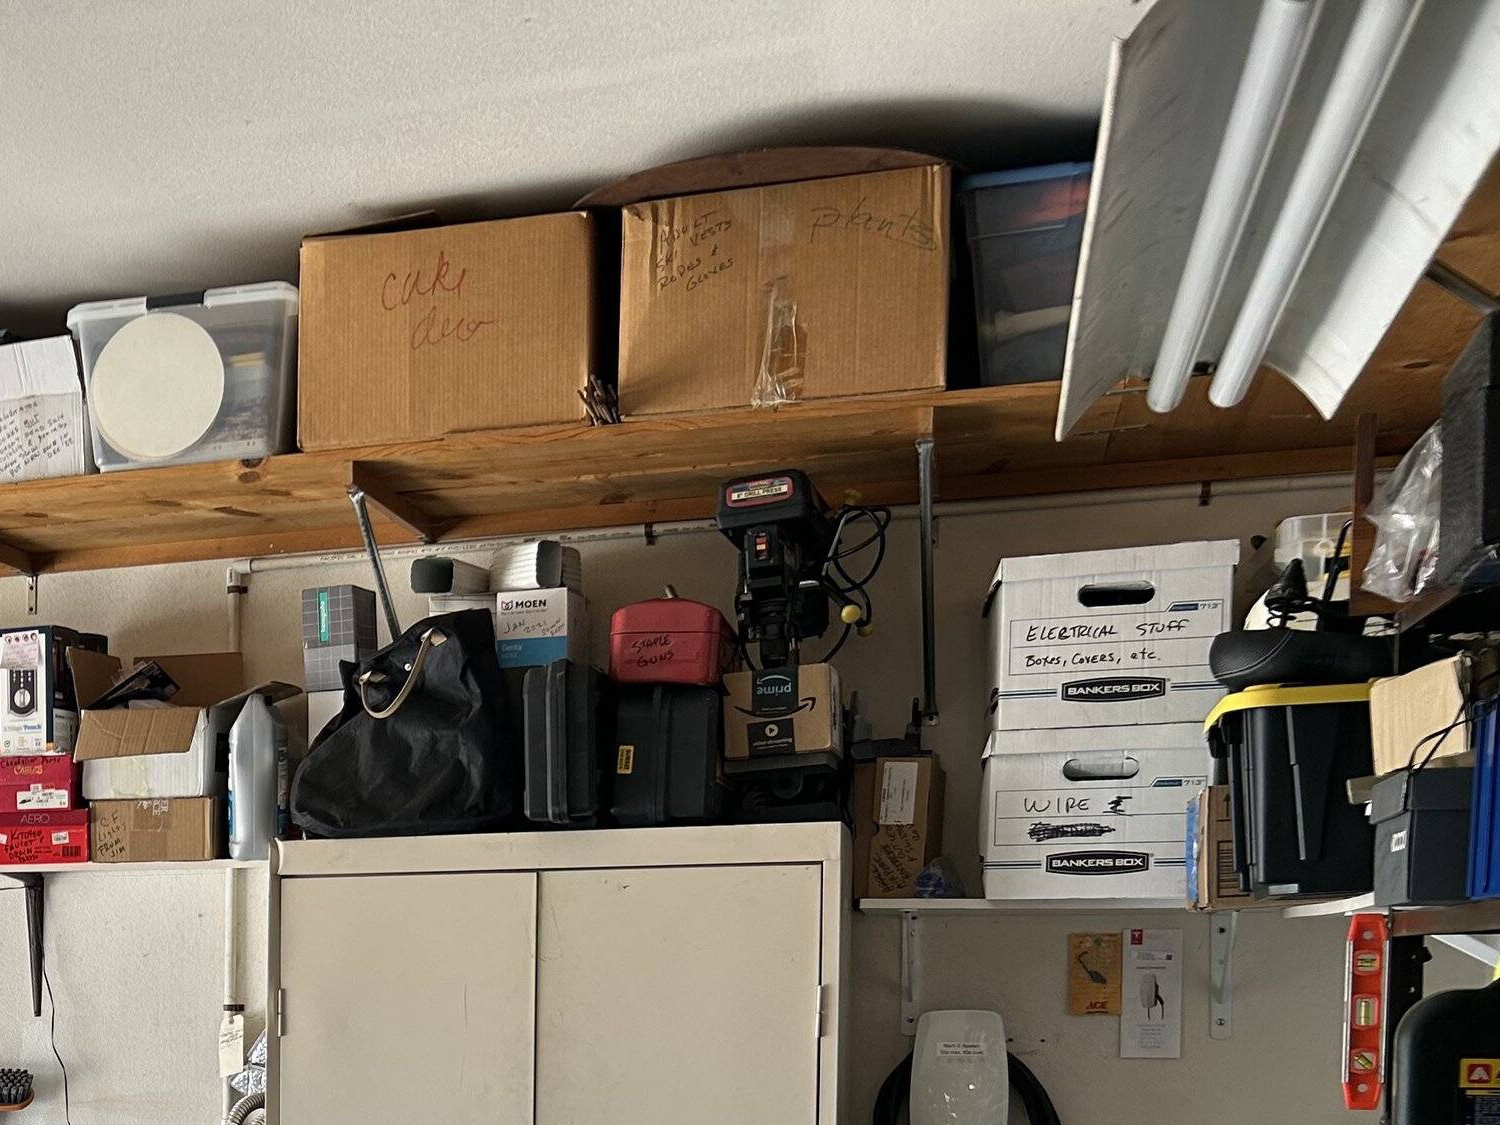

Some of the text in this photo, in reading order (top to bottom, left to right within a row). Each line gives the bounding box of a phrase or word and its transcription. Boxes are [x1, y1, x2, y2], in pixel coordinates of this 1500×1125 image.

[515, 599, 547, 609] MOEN
[1135, 618, 1191, 637] STUFF
[631, 634, 672, 654] STAPLE
[636, 651, 675, 667] GUNS
[756, 682, 792, 696] prime
[1067, 682, 1161, 697] BANKERS BOX
[1024, 797, 1090, 813] WIRE
[20, 813, 50, 824] AERO
[97, 838, 121, 856] FROM
[110, 846, 126, 858] JIM
[1052, 856, 1145, 871] BANKERS BOX
[1086, 1001, 1109, 1010] ACE
